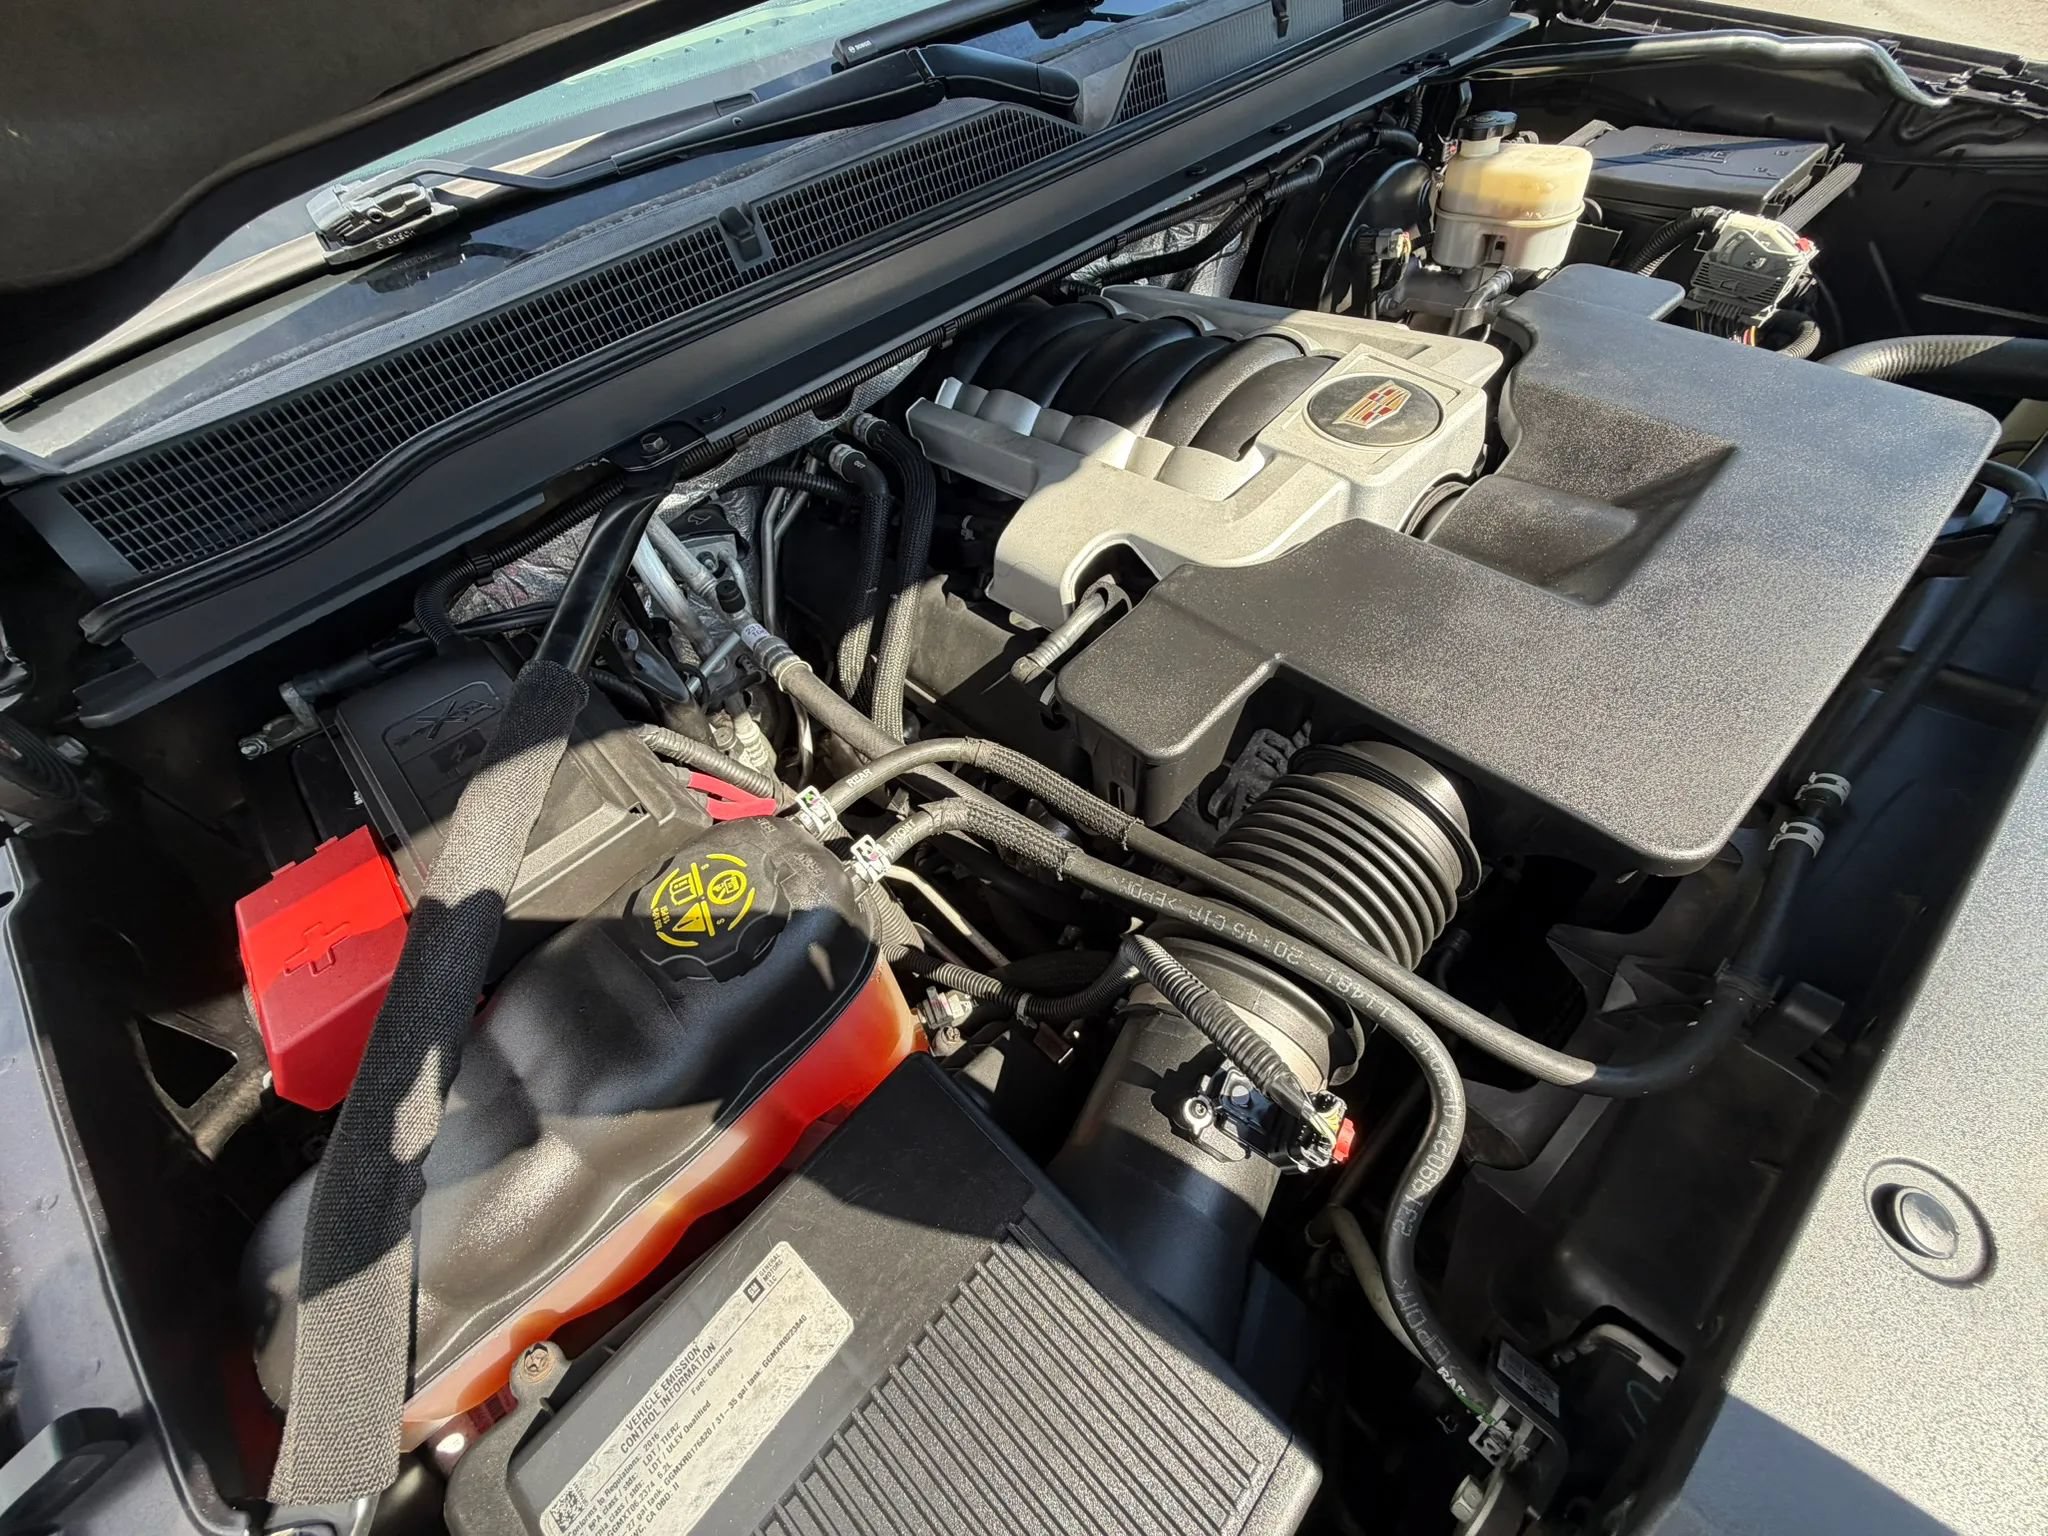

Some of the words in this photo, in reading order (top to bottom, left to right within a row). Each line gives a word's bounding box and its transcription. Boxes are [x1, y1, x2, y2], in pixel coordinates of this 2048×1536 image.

[846, 768, 873, 788] REAR
[886, 819, 917, 846] FRONT
[758, 1252, 779, 1276] GENERAL
[762, 1258, 782, 1282] MOTORS
[767, 1274, 777, 1287] LLC
[626, 1389, 661, 1431] VEHICLE
[661, 1344, 700, 1391] EMISSION
[690, 1375, 707, 1395] Fuel:
[707, 1345, 733, 1376] Gasoline
[620, 1406, 660, 1453] CONTROL
[659, 1342, 715, 1408] INFORMATION
[607, 1502, 625, 1522] class
[628, 1478, 644, 1498] stds:
[648, 1456, 662, 1474] LDT
[665, 1431, 684, 1453] ULEV
[682, 1399, 711, 1433] Qualified
[635, 1504, 648, 1521] gal
[646, 1485, 664, 1506] tank:
[736, 1384, 748, 1400] gal
[746, 1366, 763, 1386] tank:
[642, 1448, 656, 1466] LDT
[660, 1421, 680, 1445] TIER2
[596, 1495, 604, 1505] to
[603, 1452, 642, 1497] Regulations:
[643, 1431, 659, 1451] 2016
[656, 1460, 671, 1479] 6.2L
[587, 1514, 602, 1531] EPA
[601, 1494, 618, 1515] class
[621, 1471, 638, 1491] stds:
[645, 1509, 656, 1523] CA
[655, 1488, 673, 1511] OBD:
